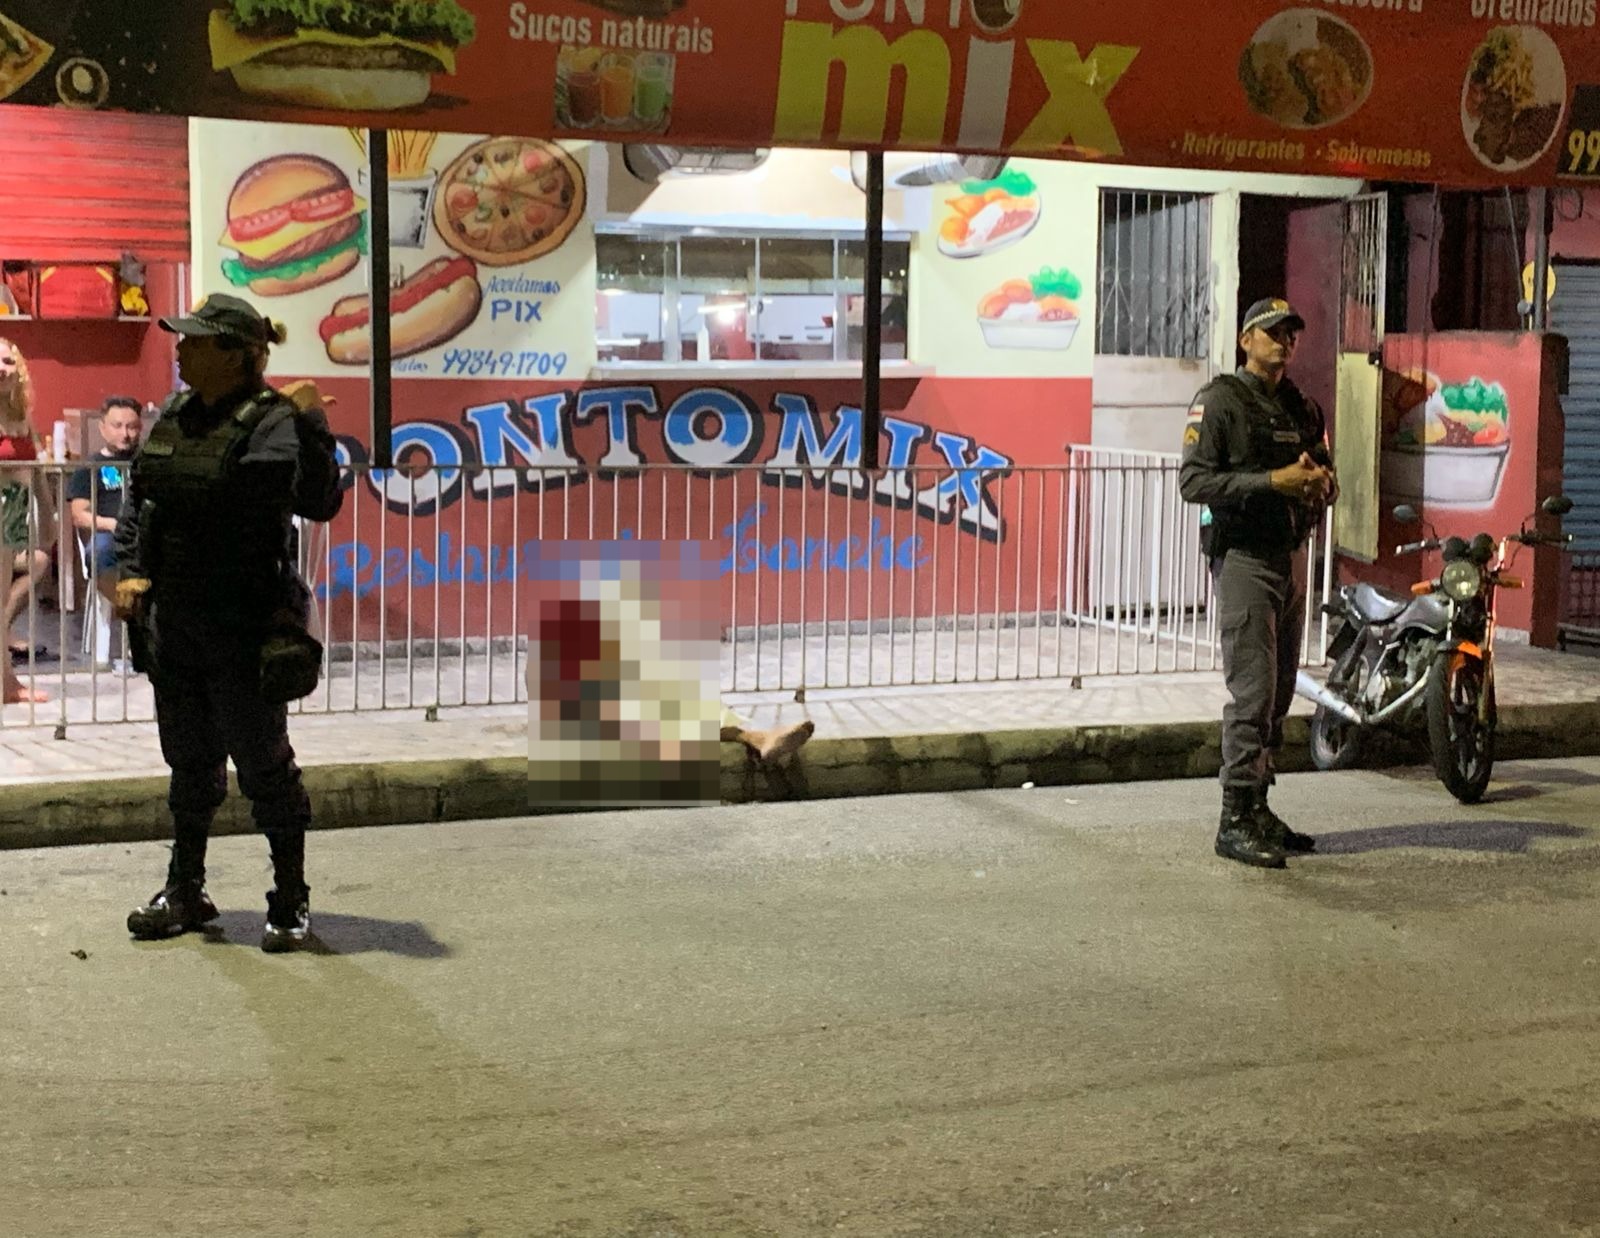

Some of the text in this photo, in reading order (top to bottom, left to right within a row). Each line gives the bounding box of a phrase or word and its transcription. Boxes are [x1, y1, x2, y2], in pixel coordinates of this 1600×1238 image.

[508, 2, 713, 54] Sucos naturais
[772, 19, 1141, 156] mix
[1182, 130, 1432, 168] Refrigerantes Sobremesas
[491, 300, 542, 322] PIX
[335, 386, 1010, 534] ONTOMIX
